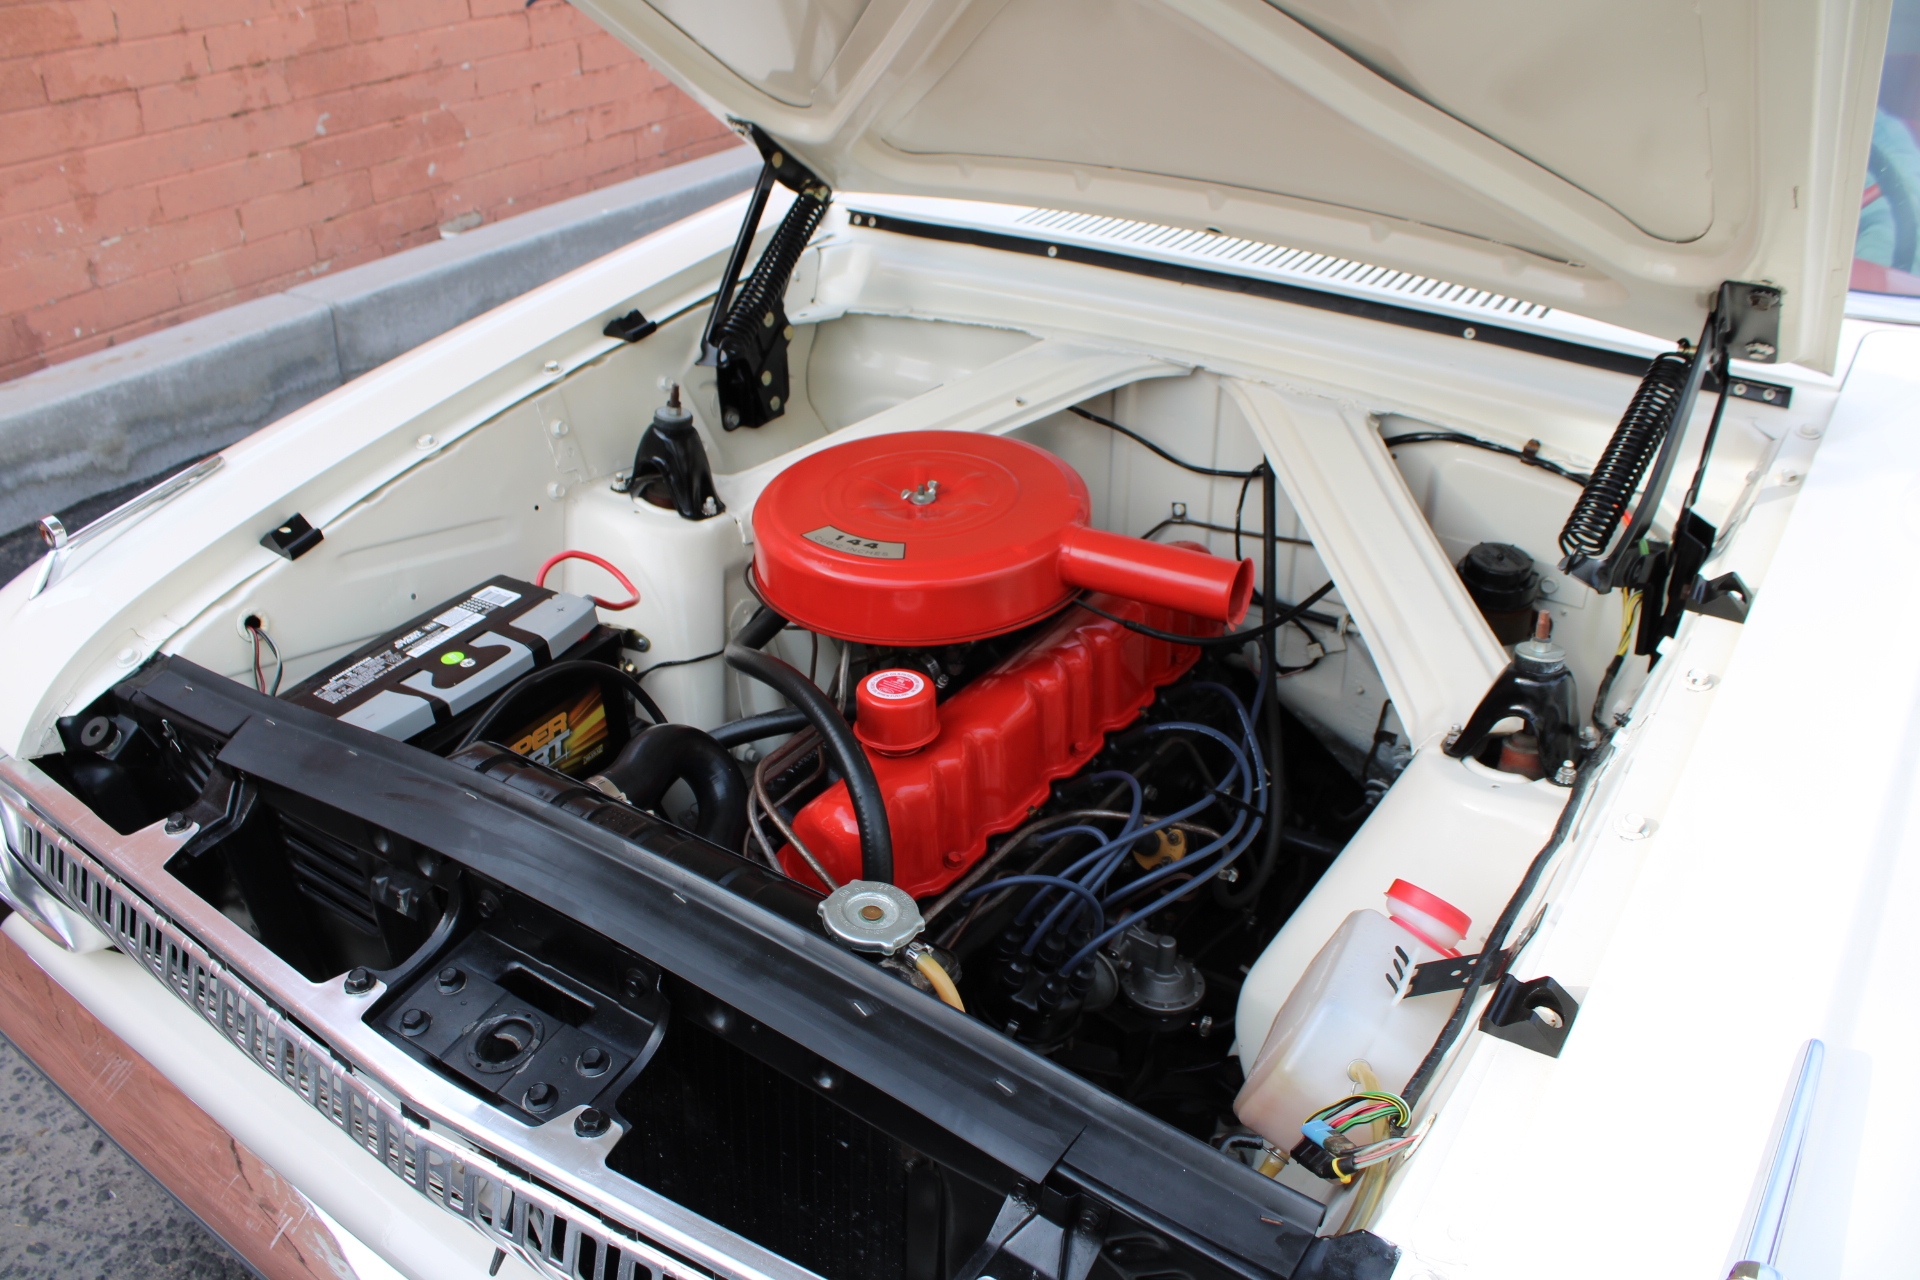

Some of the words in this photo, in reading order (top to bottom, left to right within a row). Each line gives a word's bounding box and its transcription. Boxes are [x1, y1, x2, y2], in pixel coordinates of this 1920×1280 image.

[814, 536, 843, 549] CUBIC
[846, 547, 889, 557] INCHES
[835, 535, 879, 549] 144
[509, 711, 567, 754] PER
[529, 729, 570, 765] RT
